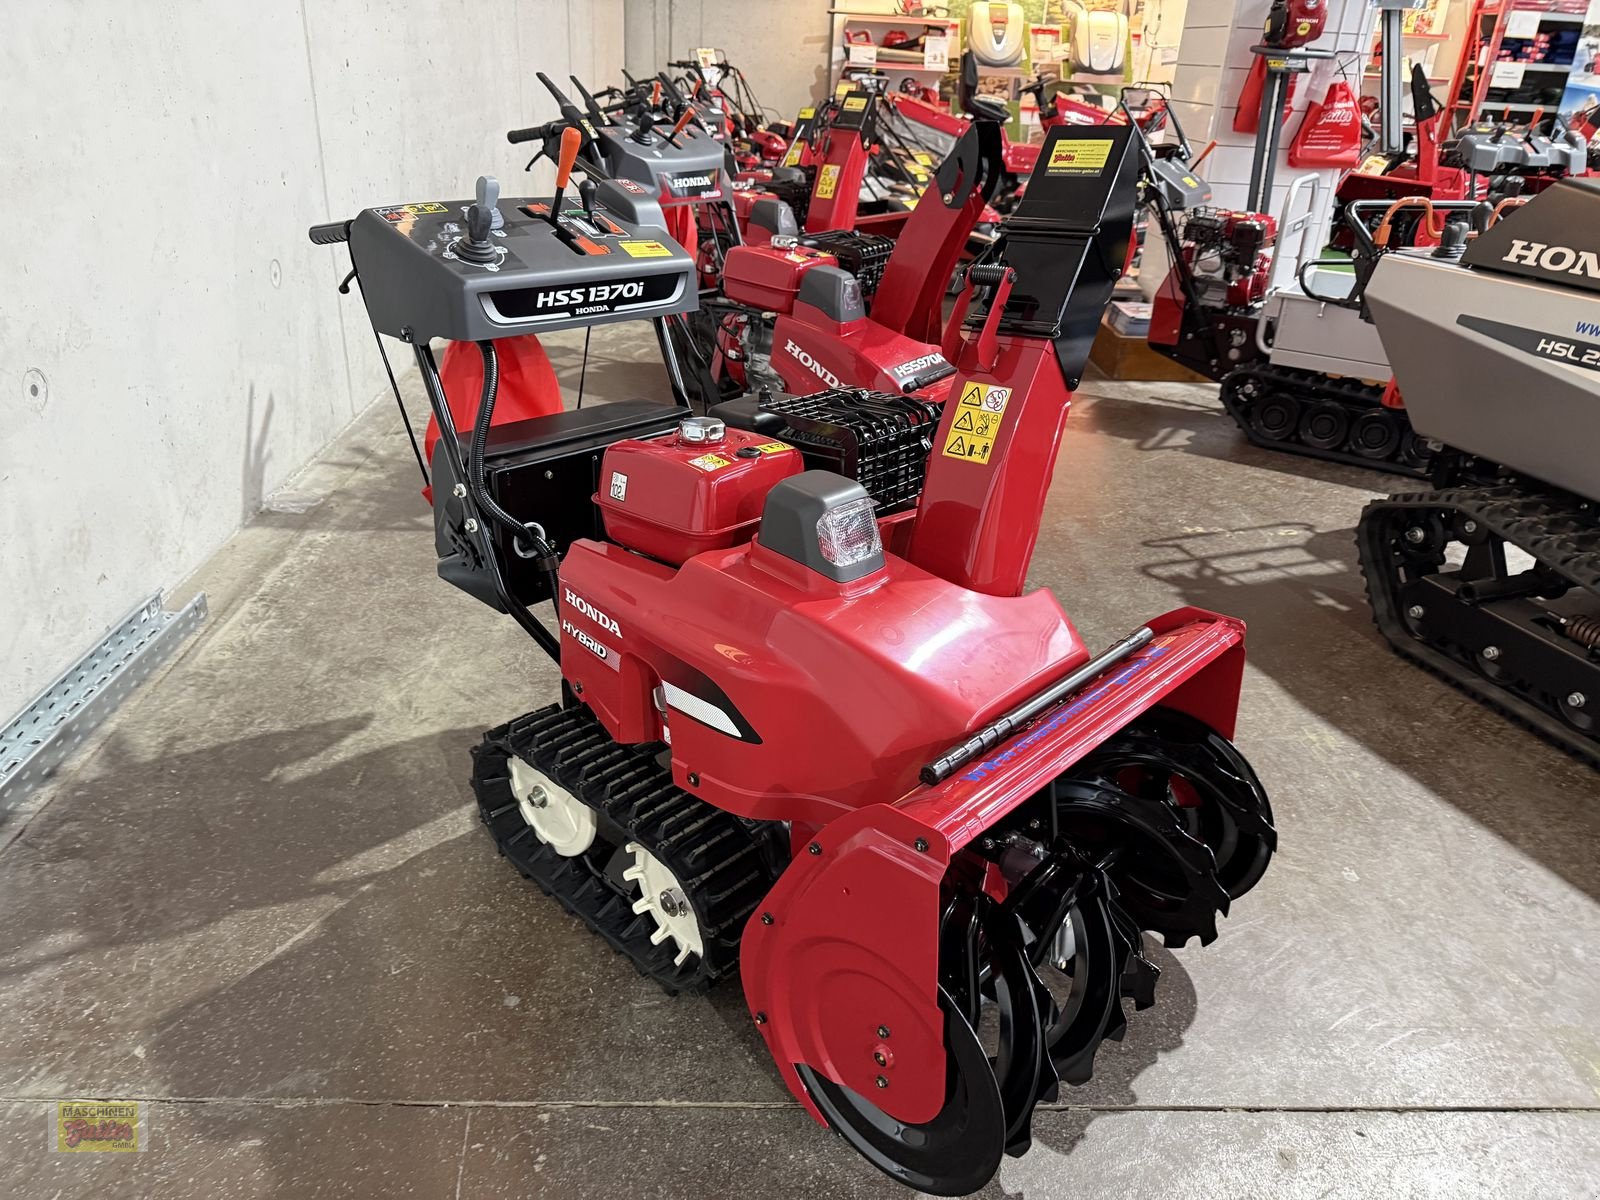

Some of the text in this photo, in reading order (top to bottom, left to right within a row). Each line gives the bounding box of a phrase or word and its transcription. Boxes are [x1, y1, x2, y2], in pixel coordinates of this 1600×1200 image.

[673, 176, 711, 189] HONDA
[536, 282, 644, 308] HSS 1370i
[575, 304, 609, 315] HONDA
[784, 339, 846, 389] HOND
[894, 352, 946, 378] HSS970A
[565, 587, 623, 639] HONDA
[562, 619, 607, 659] HYBRID
